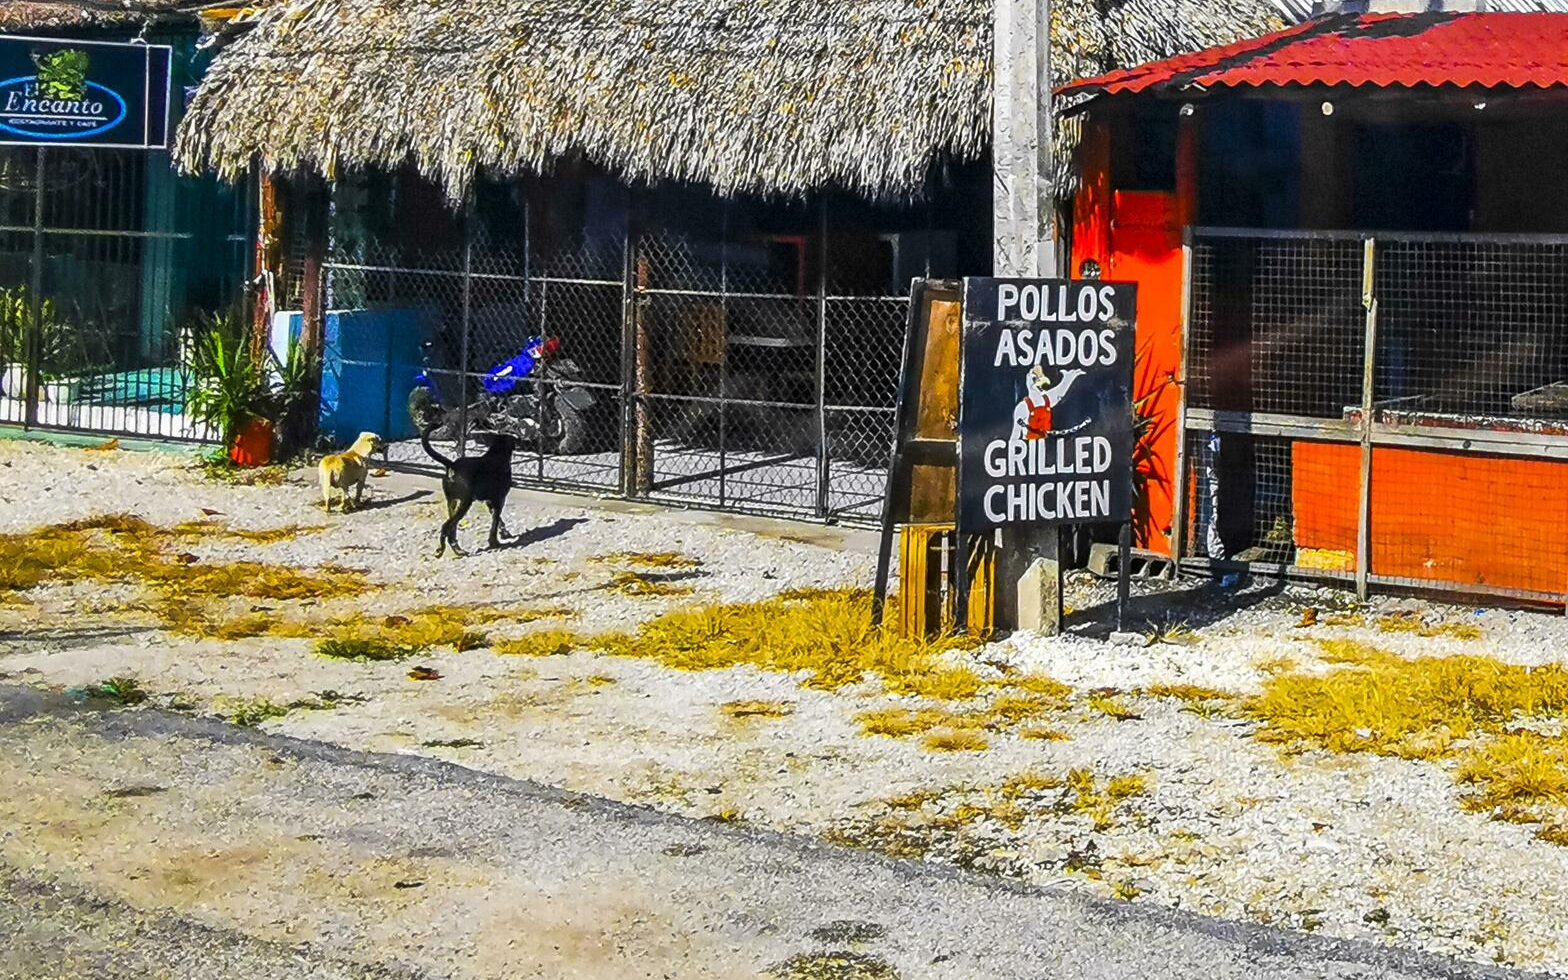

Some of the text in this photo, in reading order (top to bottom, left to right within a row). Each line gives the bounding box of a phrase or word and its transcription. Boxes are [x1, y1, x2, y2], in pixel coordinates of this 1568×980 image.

[5, 90, 103, 114] Encanto
[998, 284, 1116, 321] POLLOS
[994, 329, 1117, 367] ASADOS
[984, 436, 1112, 478] GRILLED
[983, 480, 1110, 523] CHICKEN
